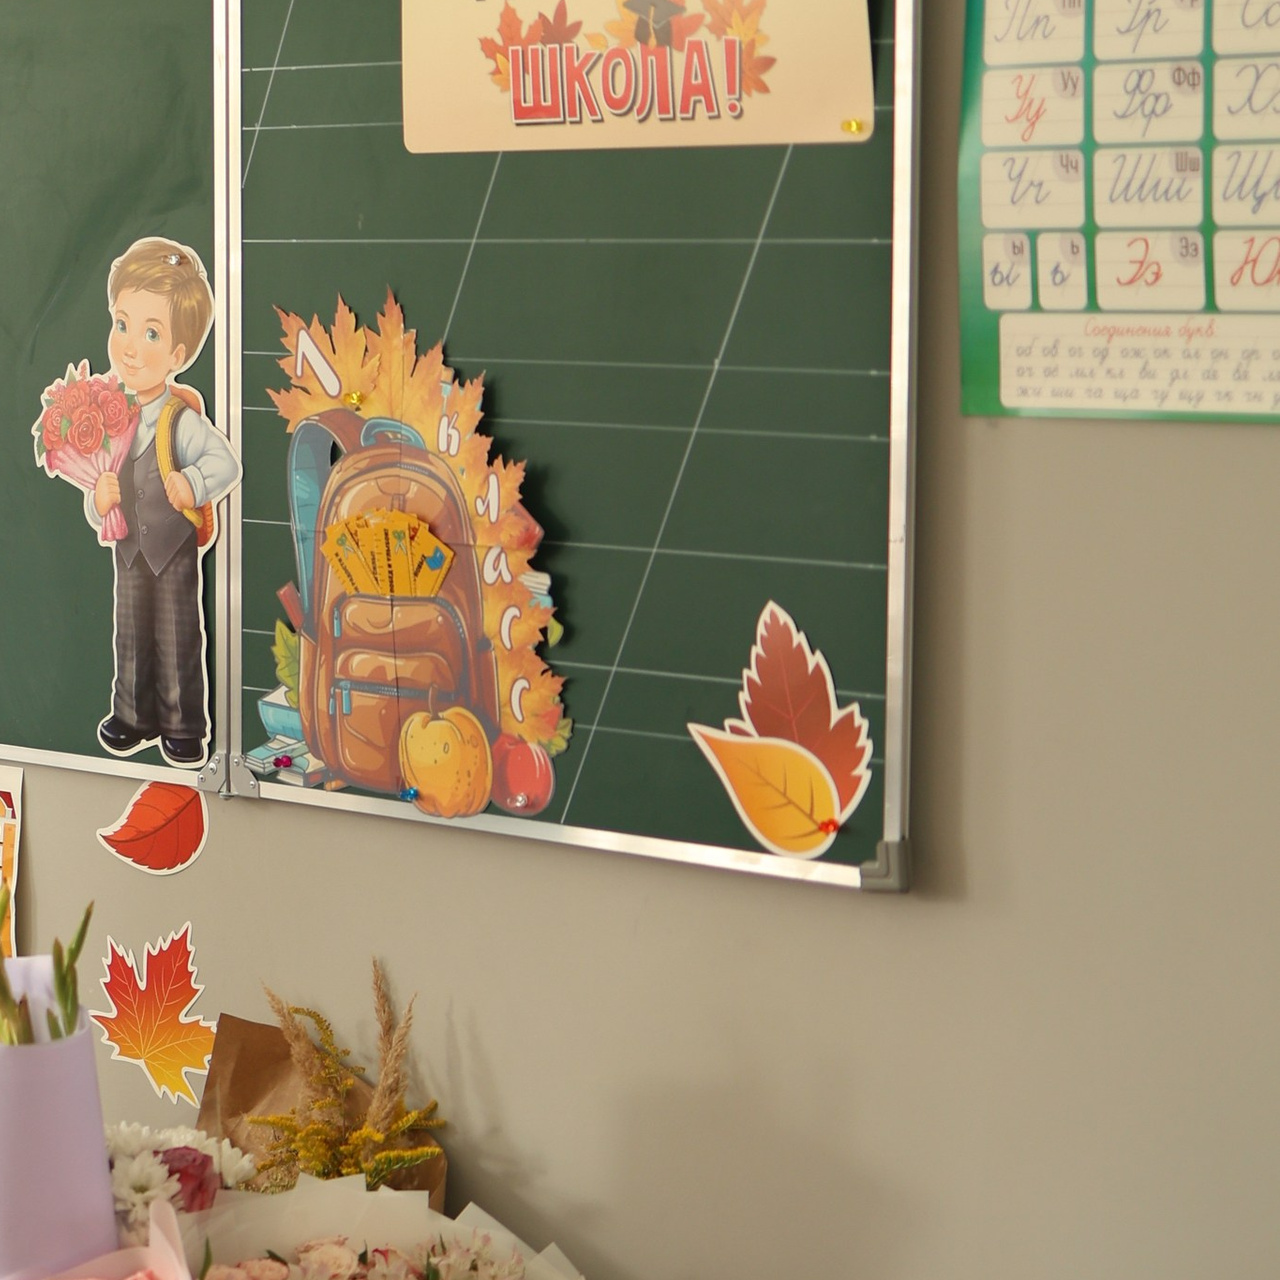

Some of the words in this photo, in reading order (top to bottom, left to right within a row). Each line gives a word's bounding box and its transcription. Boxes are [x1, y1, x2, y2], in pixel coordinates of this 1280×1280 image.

[509, 36, 742, 124] ШКОЛА!
[1060, 71, 1079, 94] Уу
[1172, 66, 1201, 92] Фф
[1059, 154, 1079, 174] Чч
[1175, 150, 1200, 172] Шш
[1179, 236, 1199, 259] Ээ
[296, 329, 342, 398] 1
